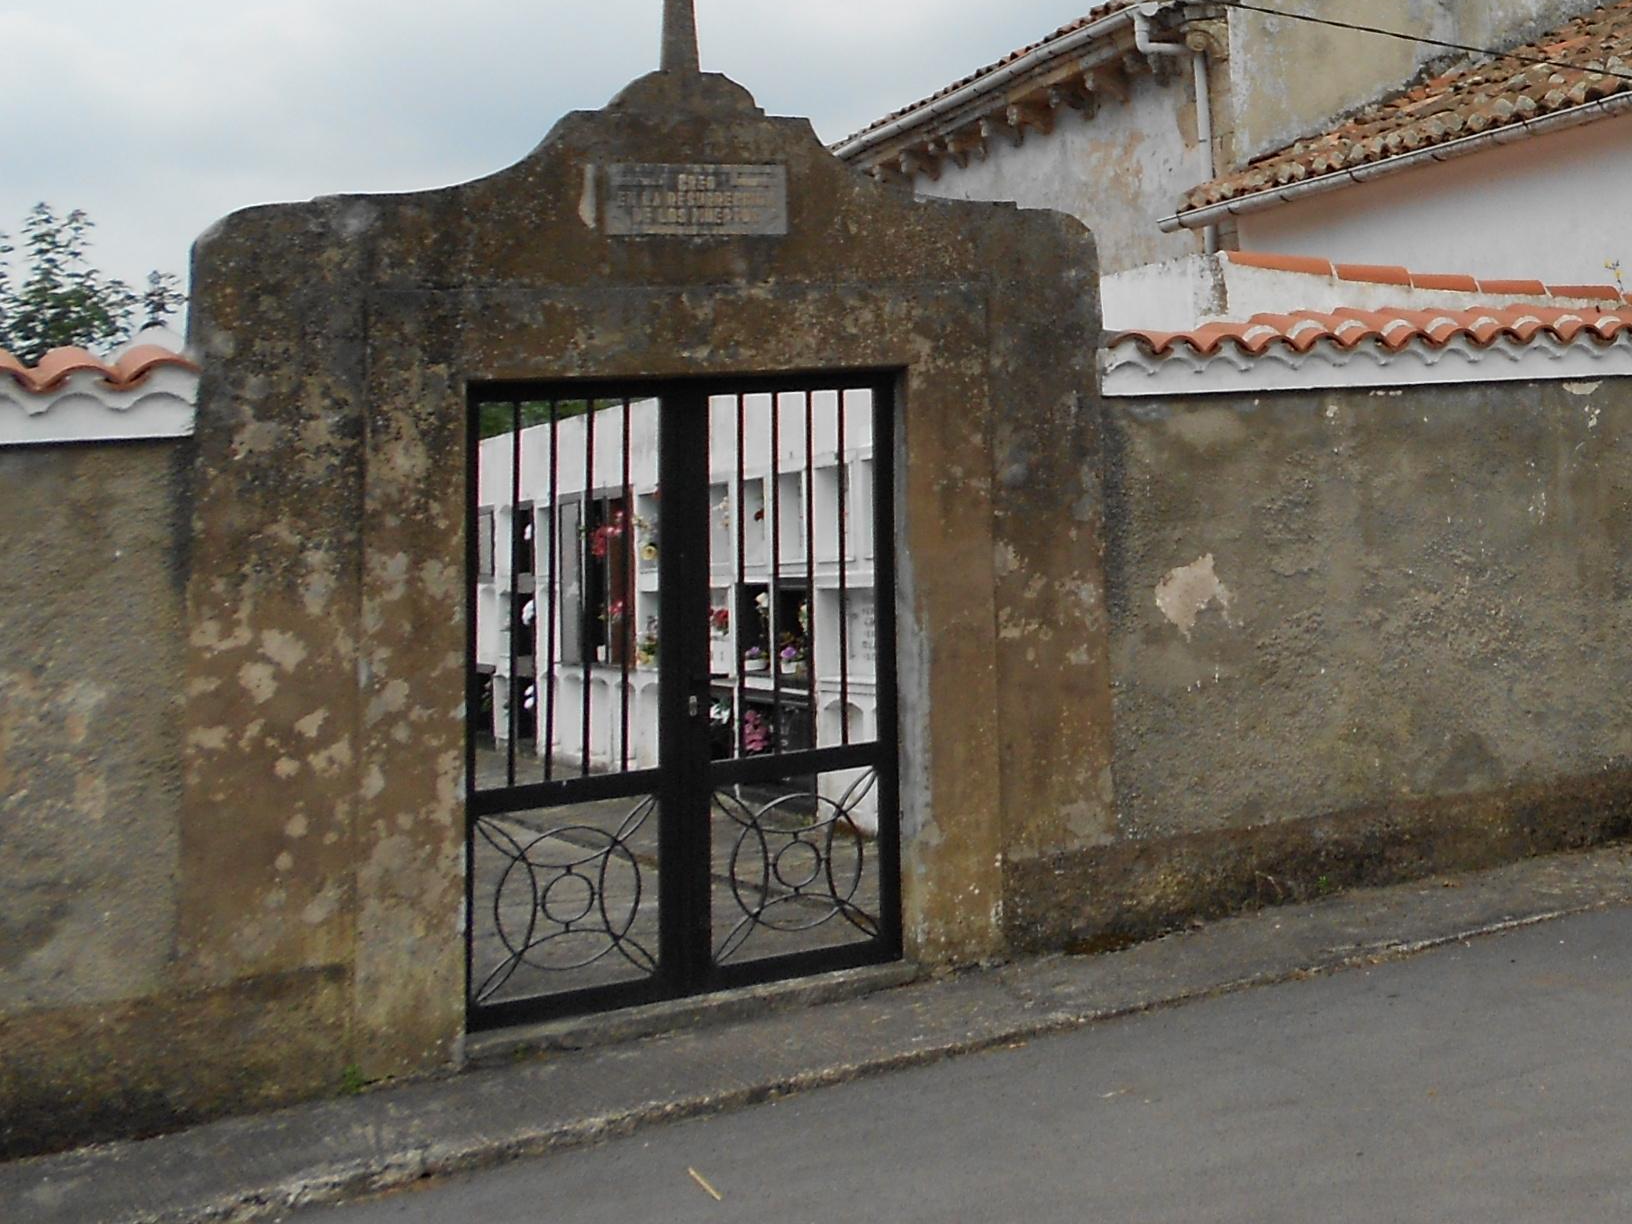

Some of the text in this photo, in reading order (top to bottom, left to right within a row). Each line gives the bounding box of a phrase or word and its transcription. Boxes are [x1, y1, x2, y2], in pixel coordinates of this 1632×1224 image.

[677, 174, 716, 190] CREO
[641, 191, 661, 206] LA
[667, 191, 775, 206] RESURREC
[632, 208, 653, 223] DE
[657, 208, 686, 223] LOS
